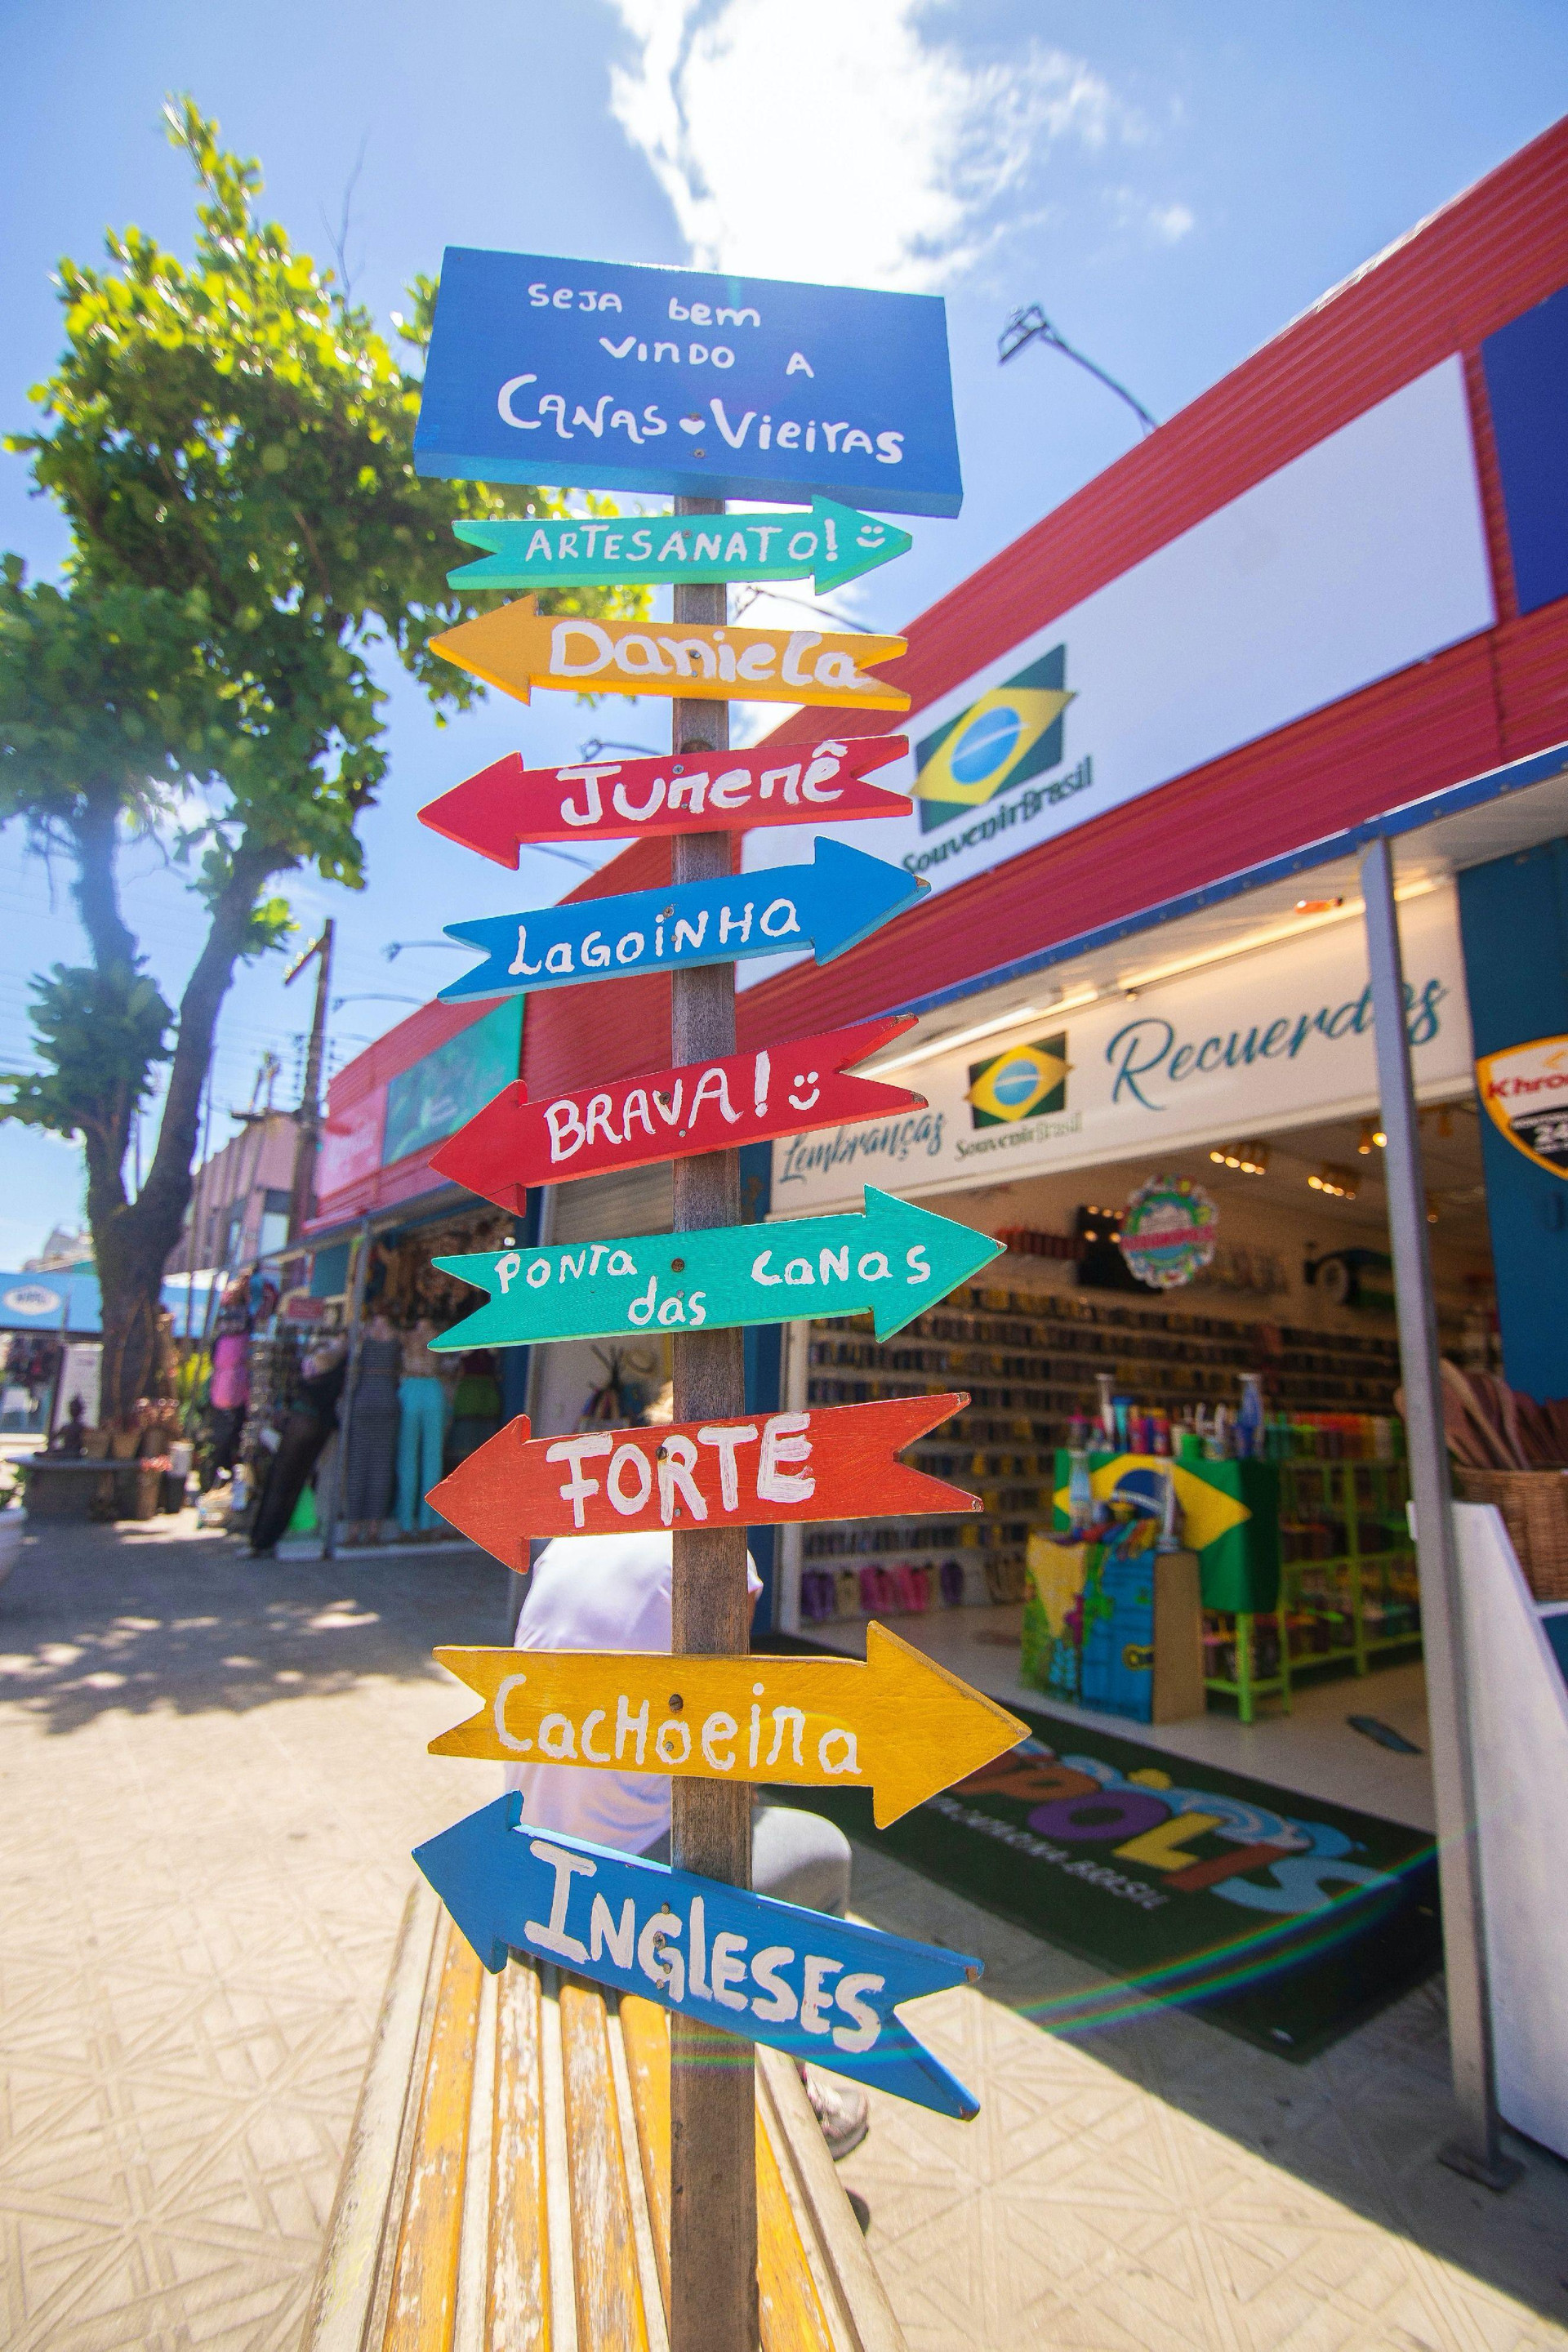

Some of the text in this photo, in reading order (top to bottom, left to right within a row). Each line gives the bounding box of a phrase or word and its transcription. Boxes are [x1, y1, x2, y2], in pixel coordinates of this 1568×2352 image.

[785, 351, 815, 378] A
[550, 620, 874, 689] Daniela
[1106, 979, 1449, 1111] Recuerds
[543, 1050, 772, 1164] BRAVA!
[546, 1411, 817, 1528] FORTE
